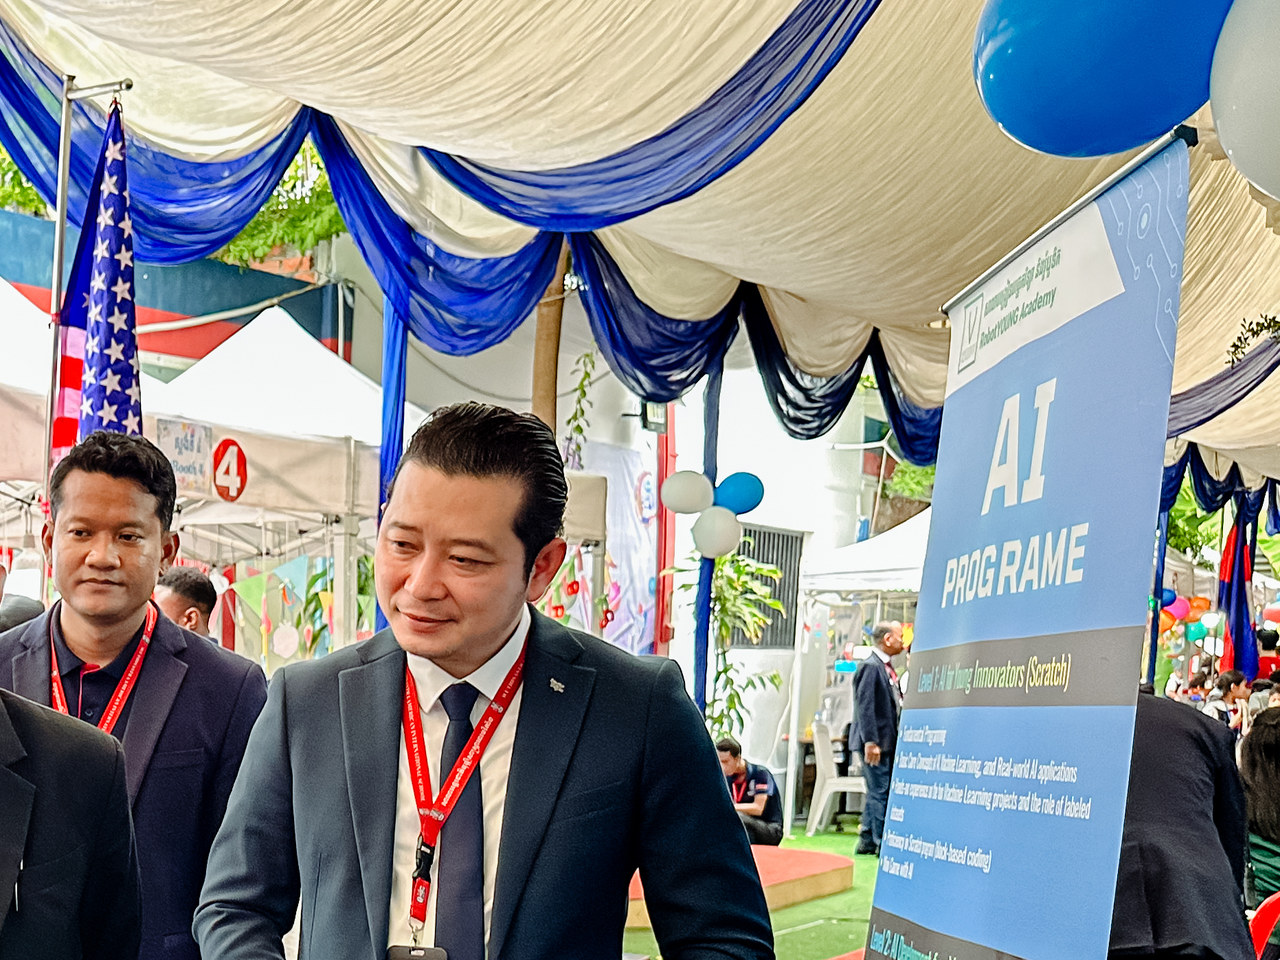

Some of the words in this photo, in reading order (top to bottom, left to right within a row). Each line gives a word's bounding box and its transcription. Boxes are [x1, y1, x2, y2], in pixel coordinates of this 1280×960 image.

[1019, 287, 1056, 321] Academy
[981, 377, 1057, 516] AI
[216, 445, 241, 497] 4
[941, 522, 1089, 609] PROGRAME
[973, 659, 1025, 688] Innovators
[1025, 653, 1071, 694] (Scratch)
[983, 757, 997, 776] and
[996, 757, 1030, 778] Real-world
[1030, 759, 1039, 779] AI
[1038, 760, 1078, 784] applications
[963, 785, 992, 811] Learning
[992, 789, 1018, 812] projects
[1018, 792, 1031, 811] and
[1030, 792, 1041, 813] the
[1041, 794, 1055, 814] role
[1055, 795, 1065, 816] of
[1064, 795, 1092, 819] labeled
[967, 848, 992, 873] coding)
